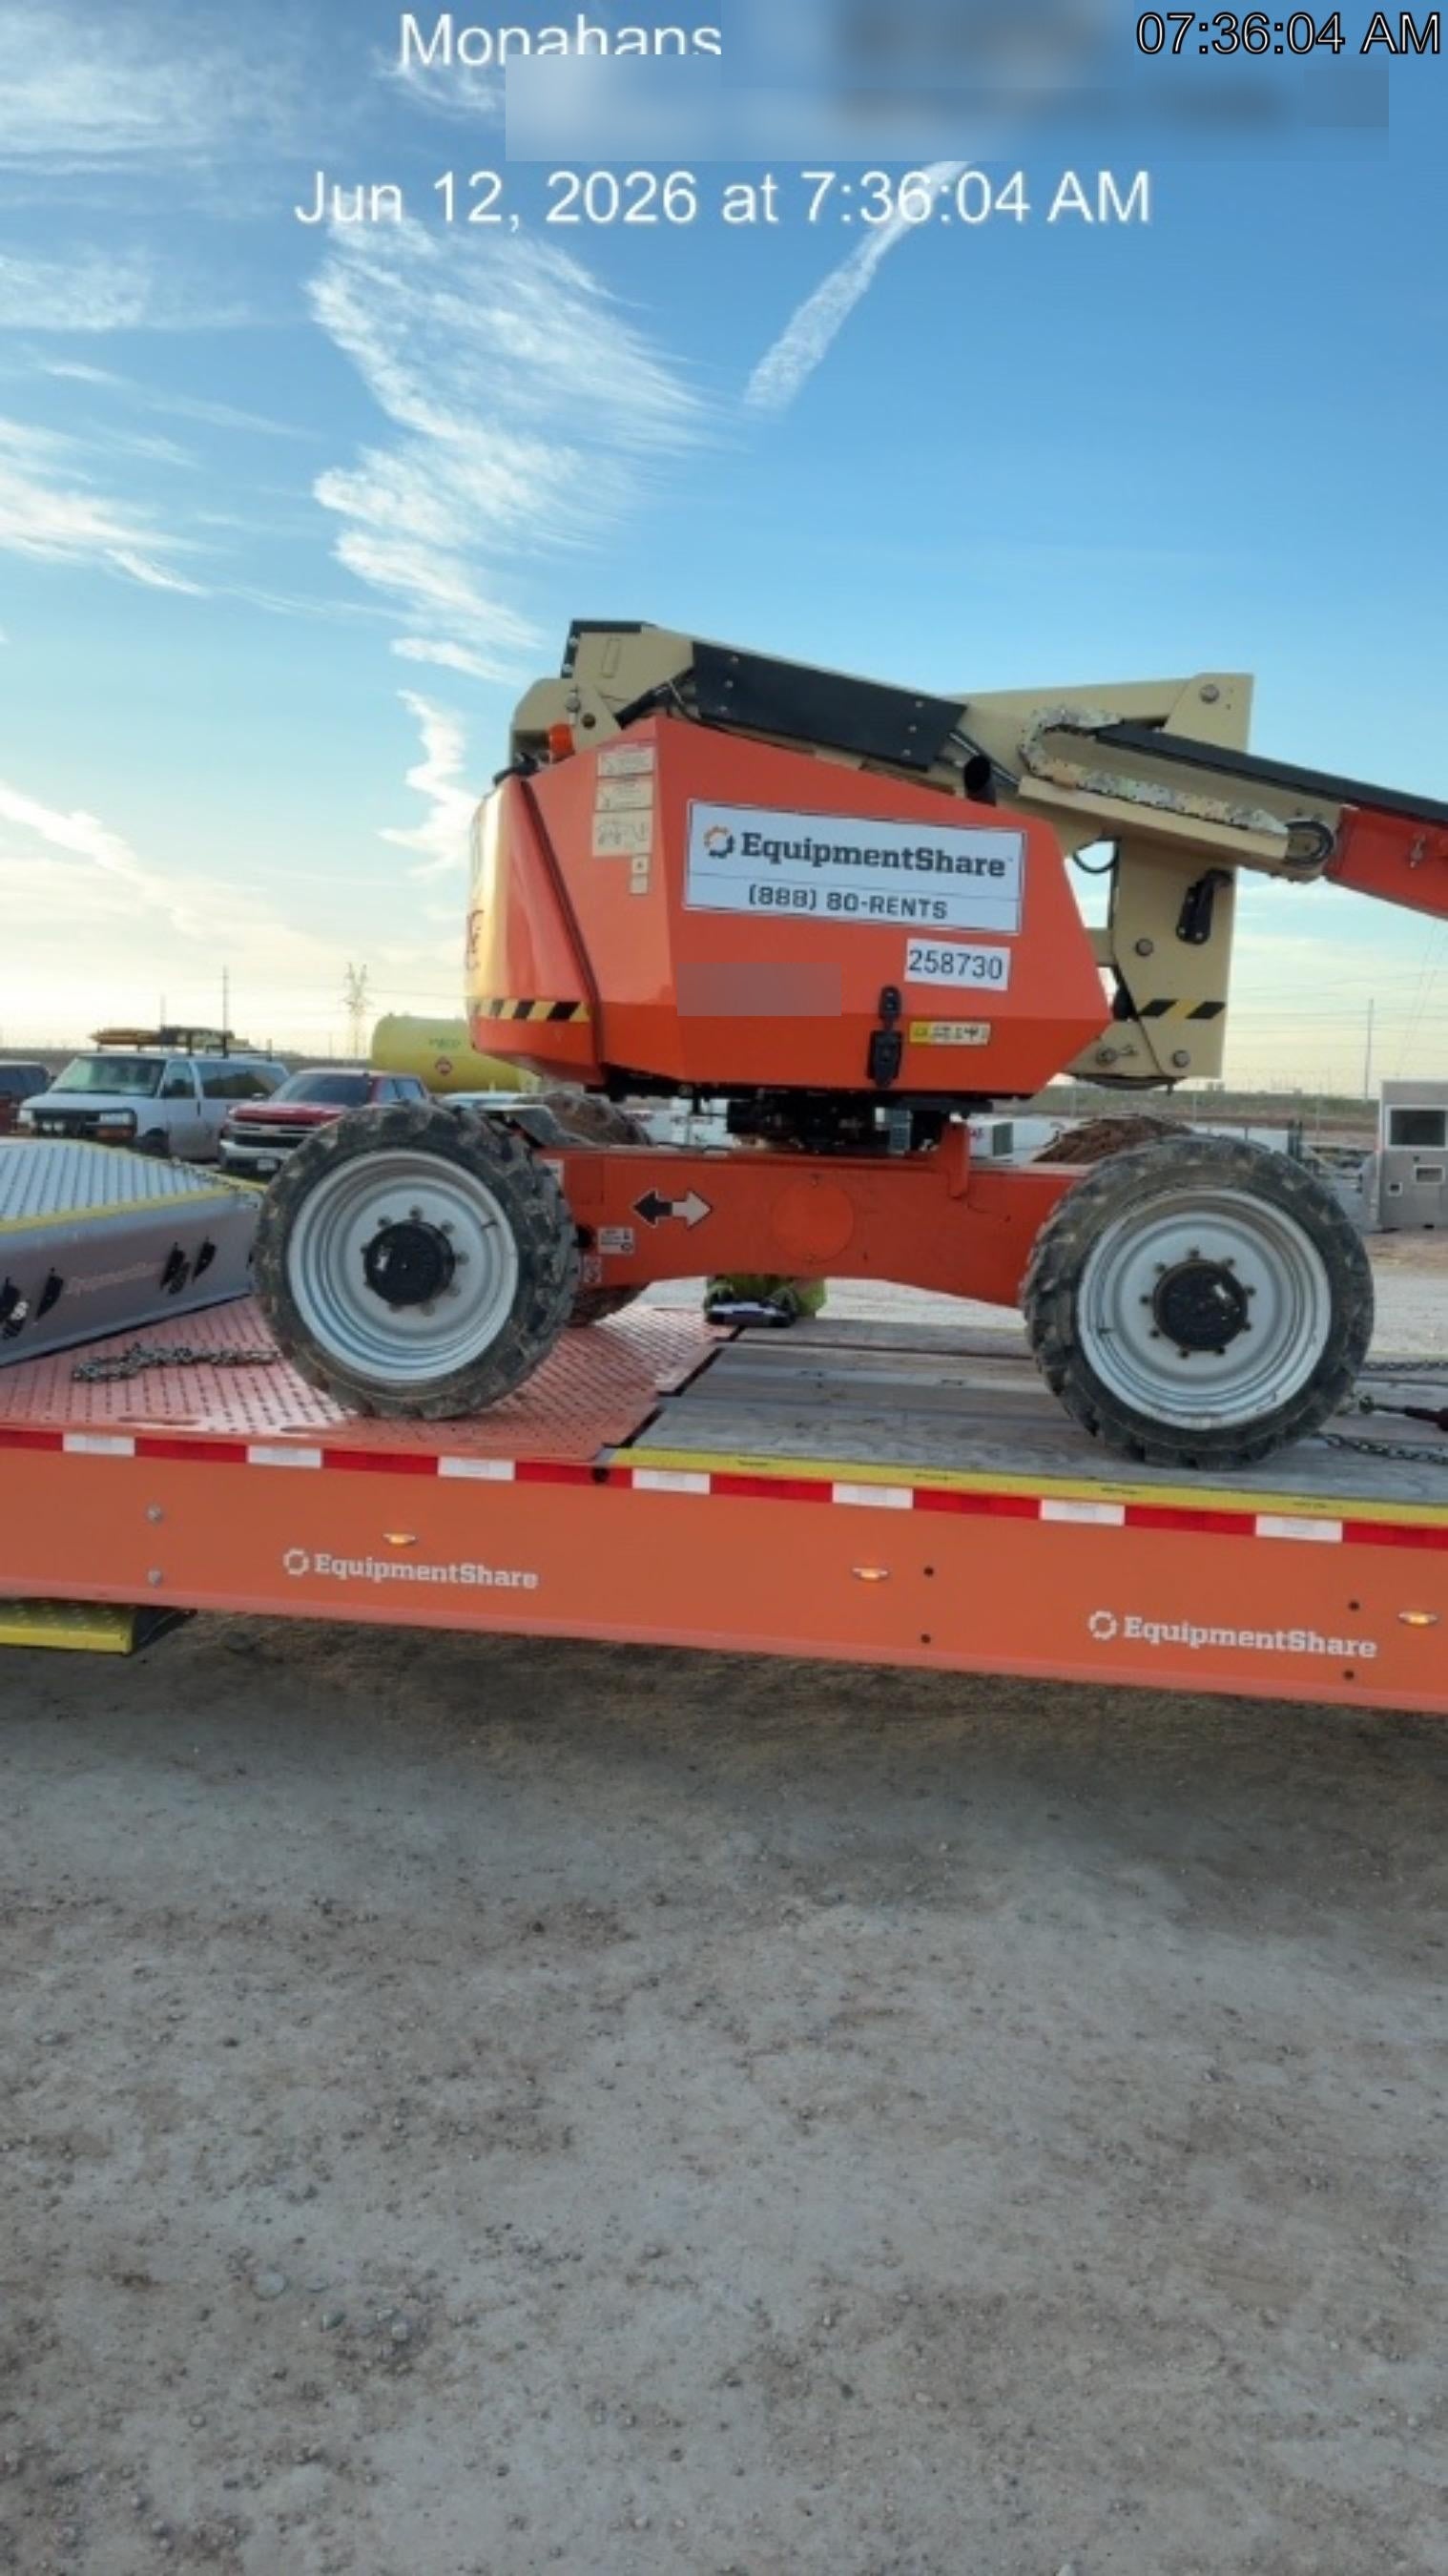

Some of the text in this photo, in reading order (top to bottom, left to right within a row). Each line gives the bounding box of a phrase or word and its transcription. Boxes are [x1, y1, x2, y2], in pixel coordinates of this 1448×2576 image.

[741, 832, 1005, 877] EquipmentShare
[749, 883, 947, 919] (888) 80-RENTS
[908, 949, 1003, 980] 258730
[314, 1553, 539, 1589] EquipmentShare
[1124, 1616, 1377, 1657] EquipmentShare
